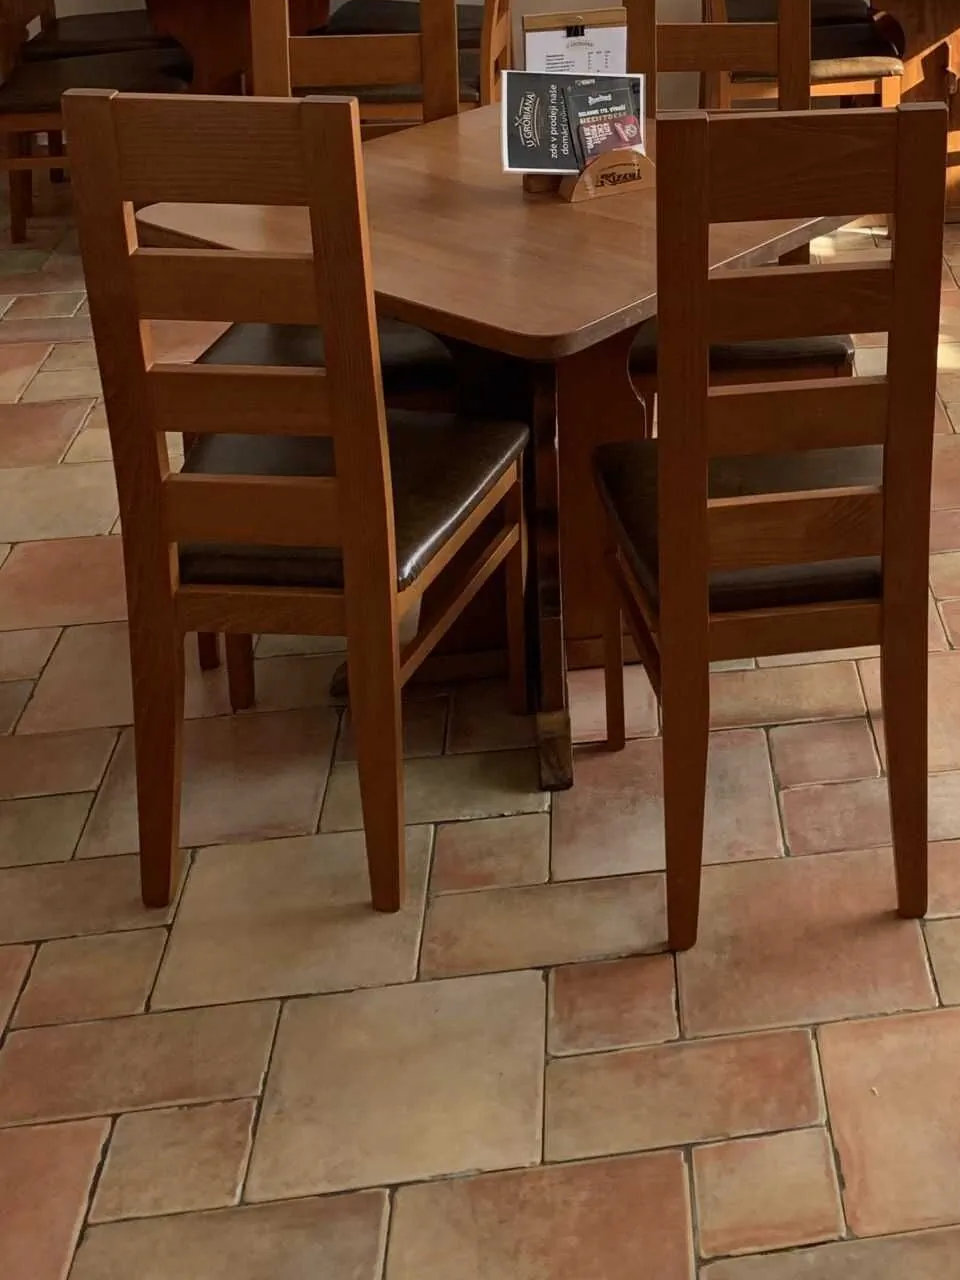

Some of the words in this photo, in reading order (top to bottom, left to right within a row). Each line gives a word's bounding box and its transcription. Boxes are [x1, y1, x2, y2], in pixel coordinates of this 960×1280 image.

[549, 84, 558, 104] naše
[548, 105, 559, 136] prodeji
[549, 143, 558, 158] zde
